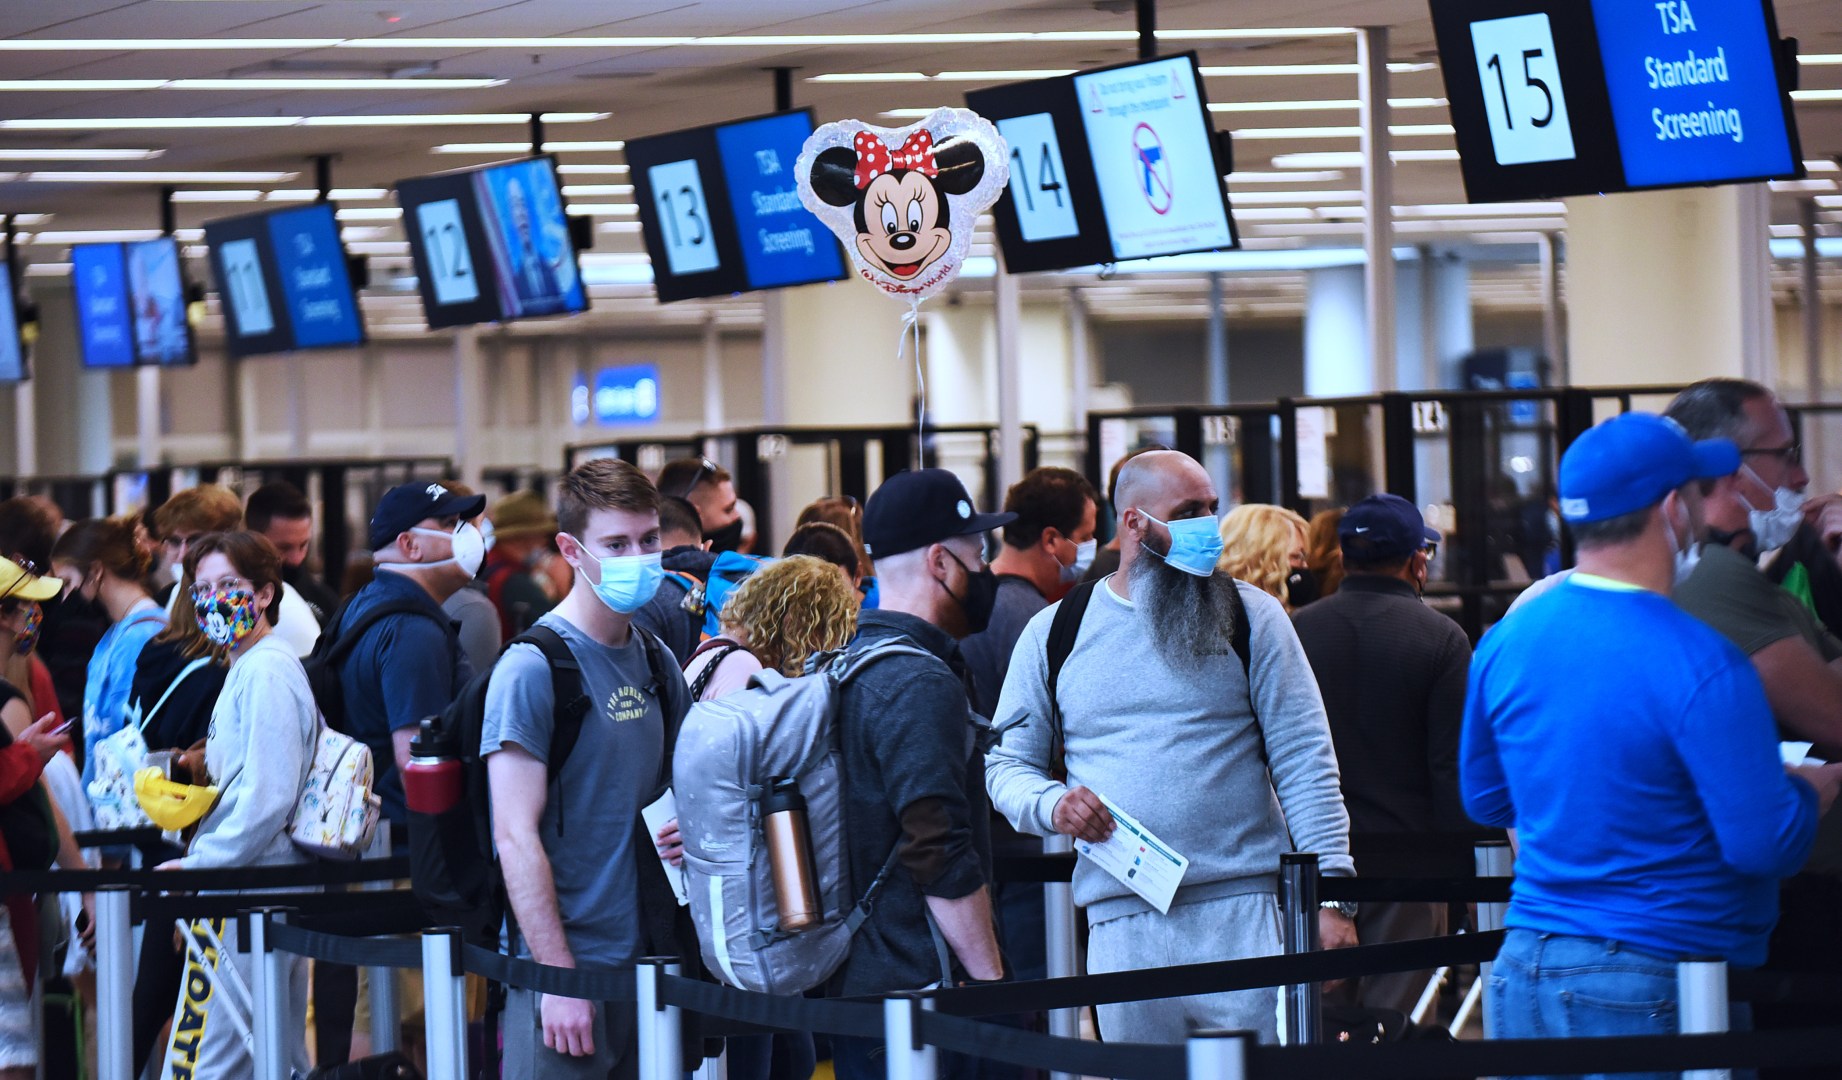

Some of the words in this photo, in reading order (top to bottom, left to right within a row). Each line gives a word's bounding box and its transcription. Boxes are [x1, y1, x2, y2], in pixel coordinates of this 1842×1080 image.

[1655, 0, 1697, 34] TSA
[1487, 48, 1554, 130] 15
[1645, 46, 1729, 89] Standard
[1652, 101, 1743, 143] Screening
[1011, 142, 1063, 211] 14
[661, 186, 706, 247] 13
[426, 223, 470, 278] 12
[615, 708, 643, 722] COMPANY
